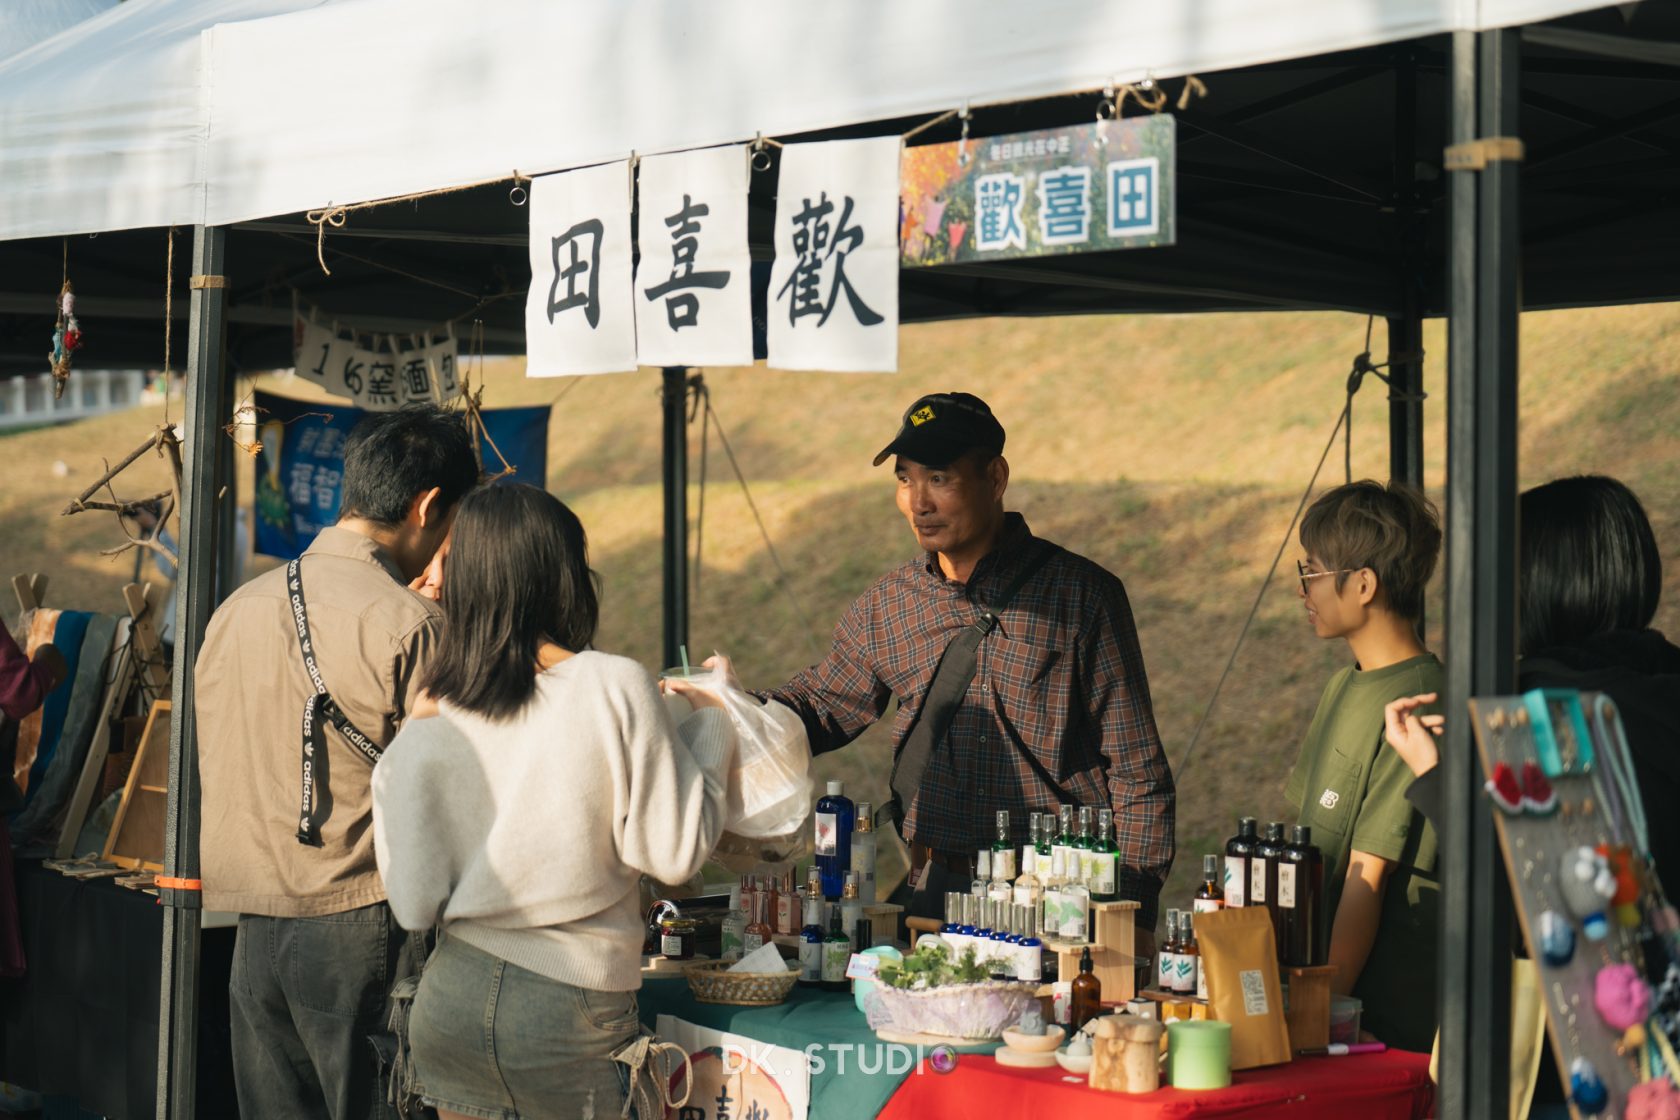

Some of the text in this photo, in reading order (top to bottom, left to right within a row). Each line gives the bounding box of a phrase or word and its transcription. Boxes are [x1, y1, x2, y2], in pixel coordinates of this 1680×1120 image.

[976, 158, 1160, 251] 歡喜田
[292, 594, 307, 638] adidas
[306, 656, 326, 695] adida
[302, 760, 313, 813] adidas
